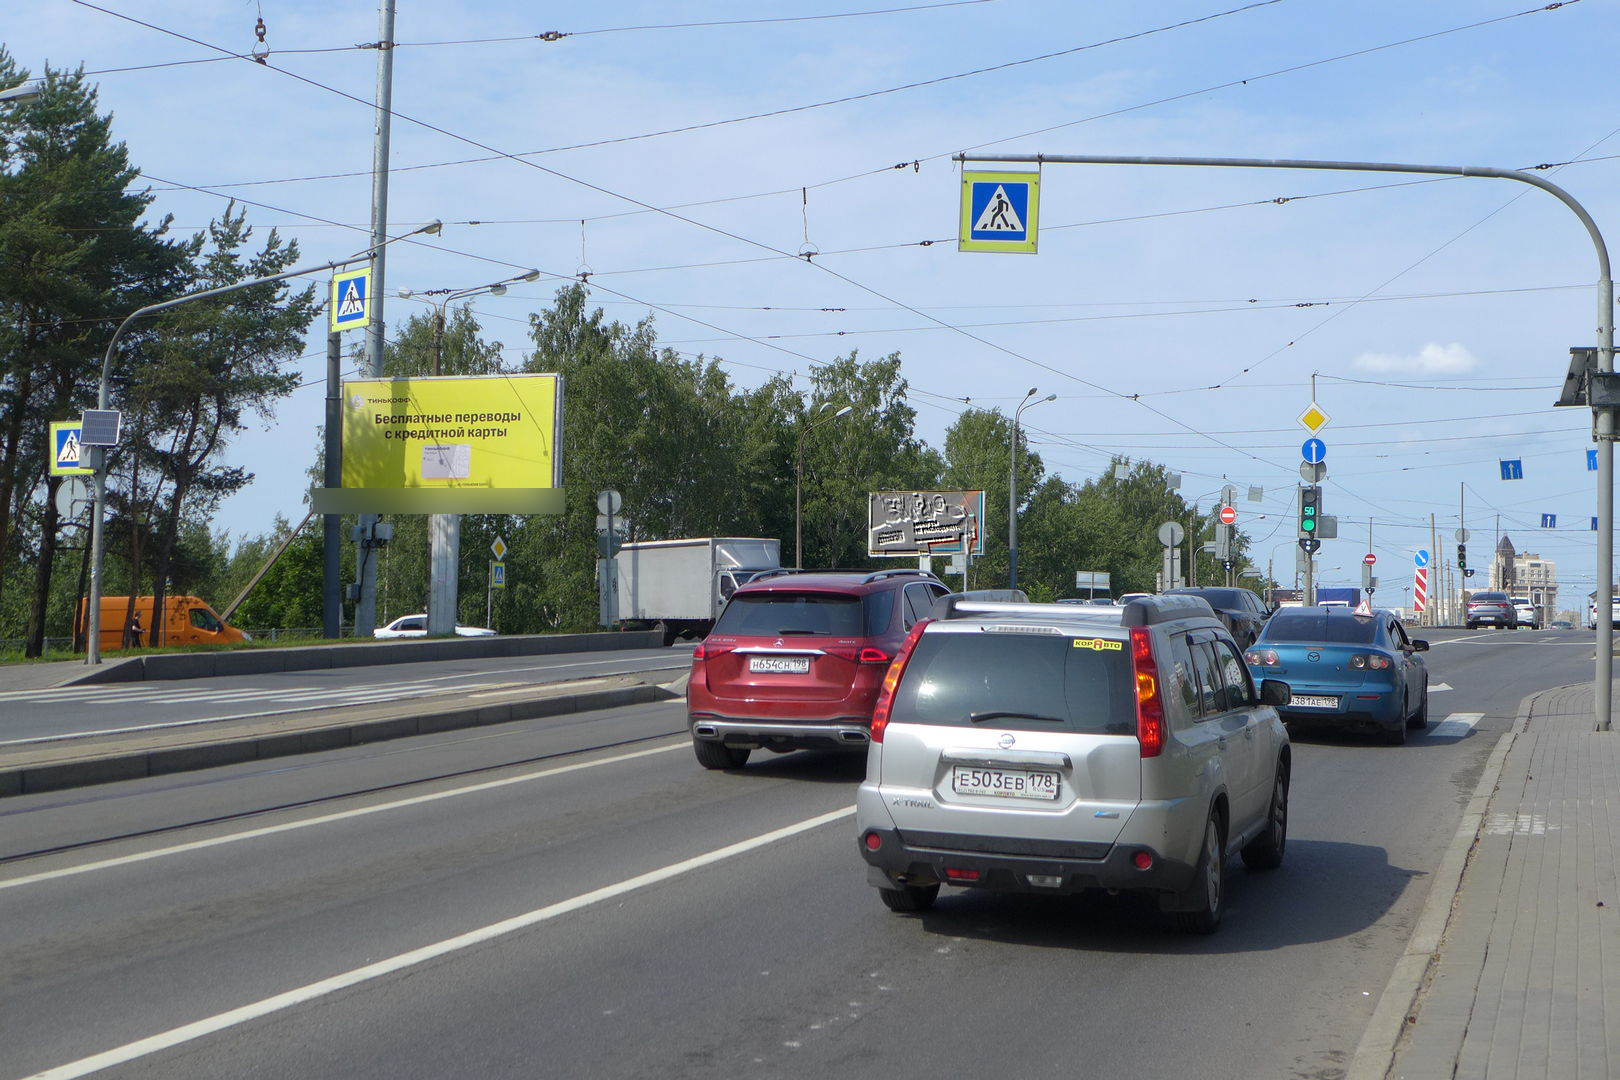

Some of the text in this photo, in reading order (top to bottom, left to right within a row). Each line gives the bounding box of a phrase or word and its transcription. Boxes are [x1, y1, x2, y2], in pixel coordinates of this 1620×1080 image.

[375, 412, 521, 424] Бесплатные переводы
[385, 427, 507, 440] с кредитной карты
[1304, 507, 1315, 515] 50
[753, 659, 790, 669] Н654СН
[960, 770, 1052, 790] Е503ЕВ 178
